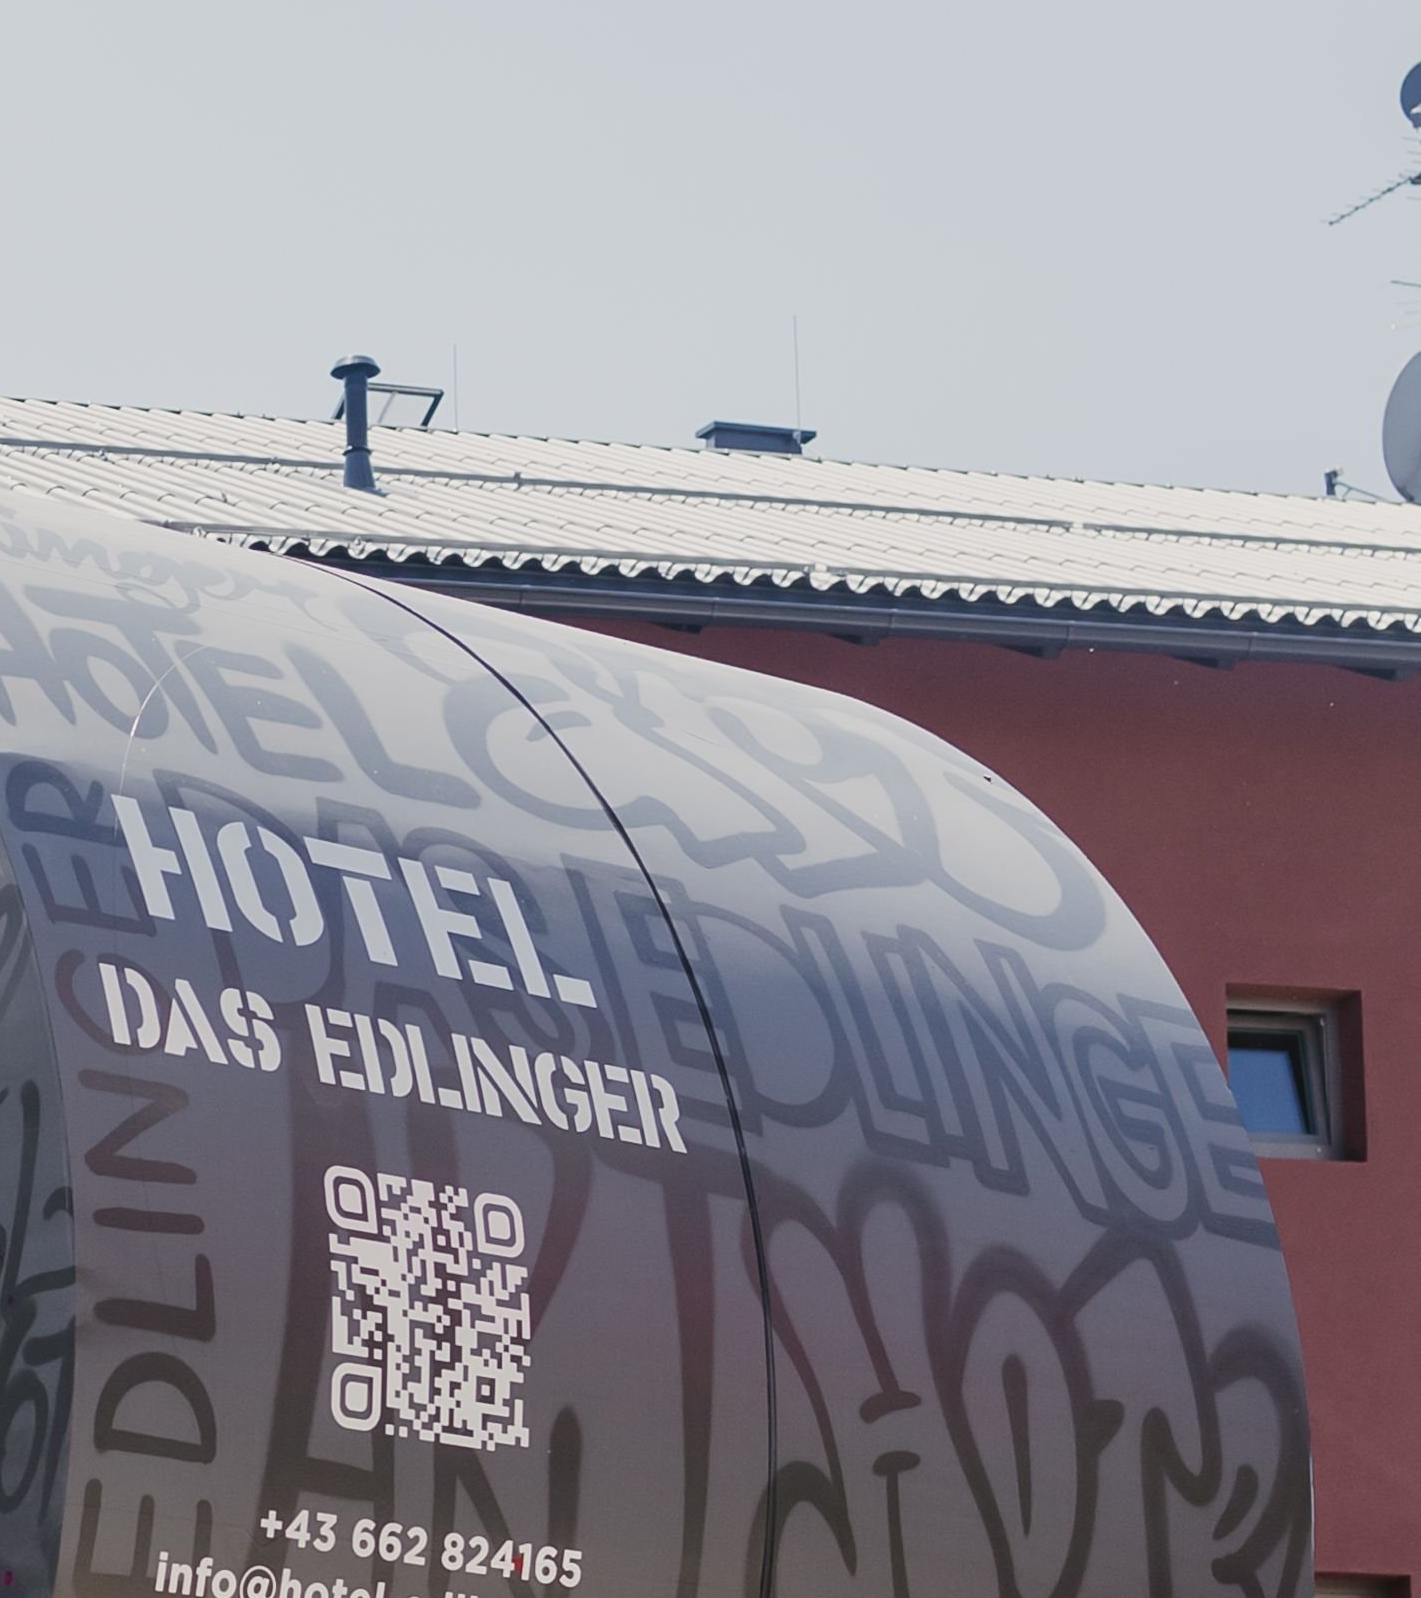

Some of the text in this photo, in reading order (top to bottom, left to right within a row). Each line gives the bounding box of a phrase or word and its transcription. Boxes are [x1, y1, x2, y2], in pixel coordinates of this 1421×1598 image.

[110, 793, 597, 1008] HOTEL
[99, 962, 281, 1072] DAS
[305, 1003, 687, 1154] EDLINGER
[260, 1509, 583, 1588] +43 662 824165
